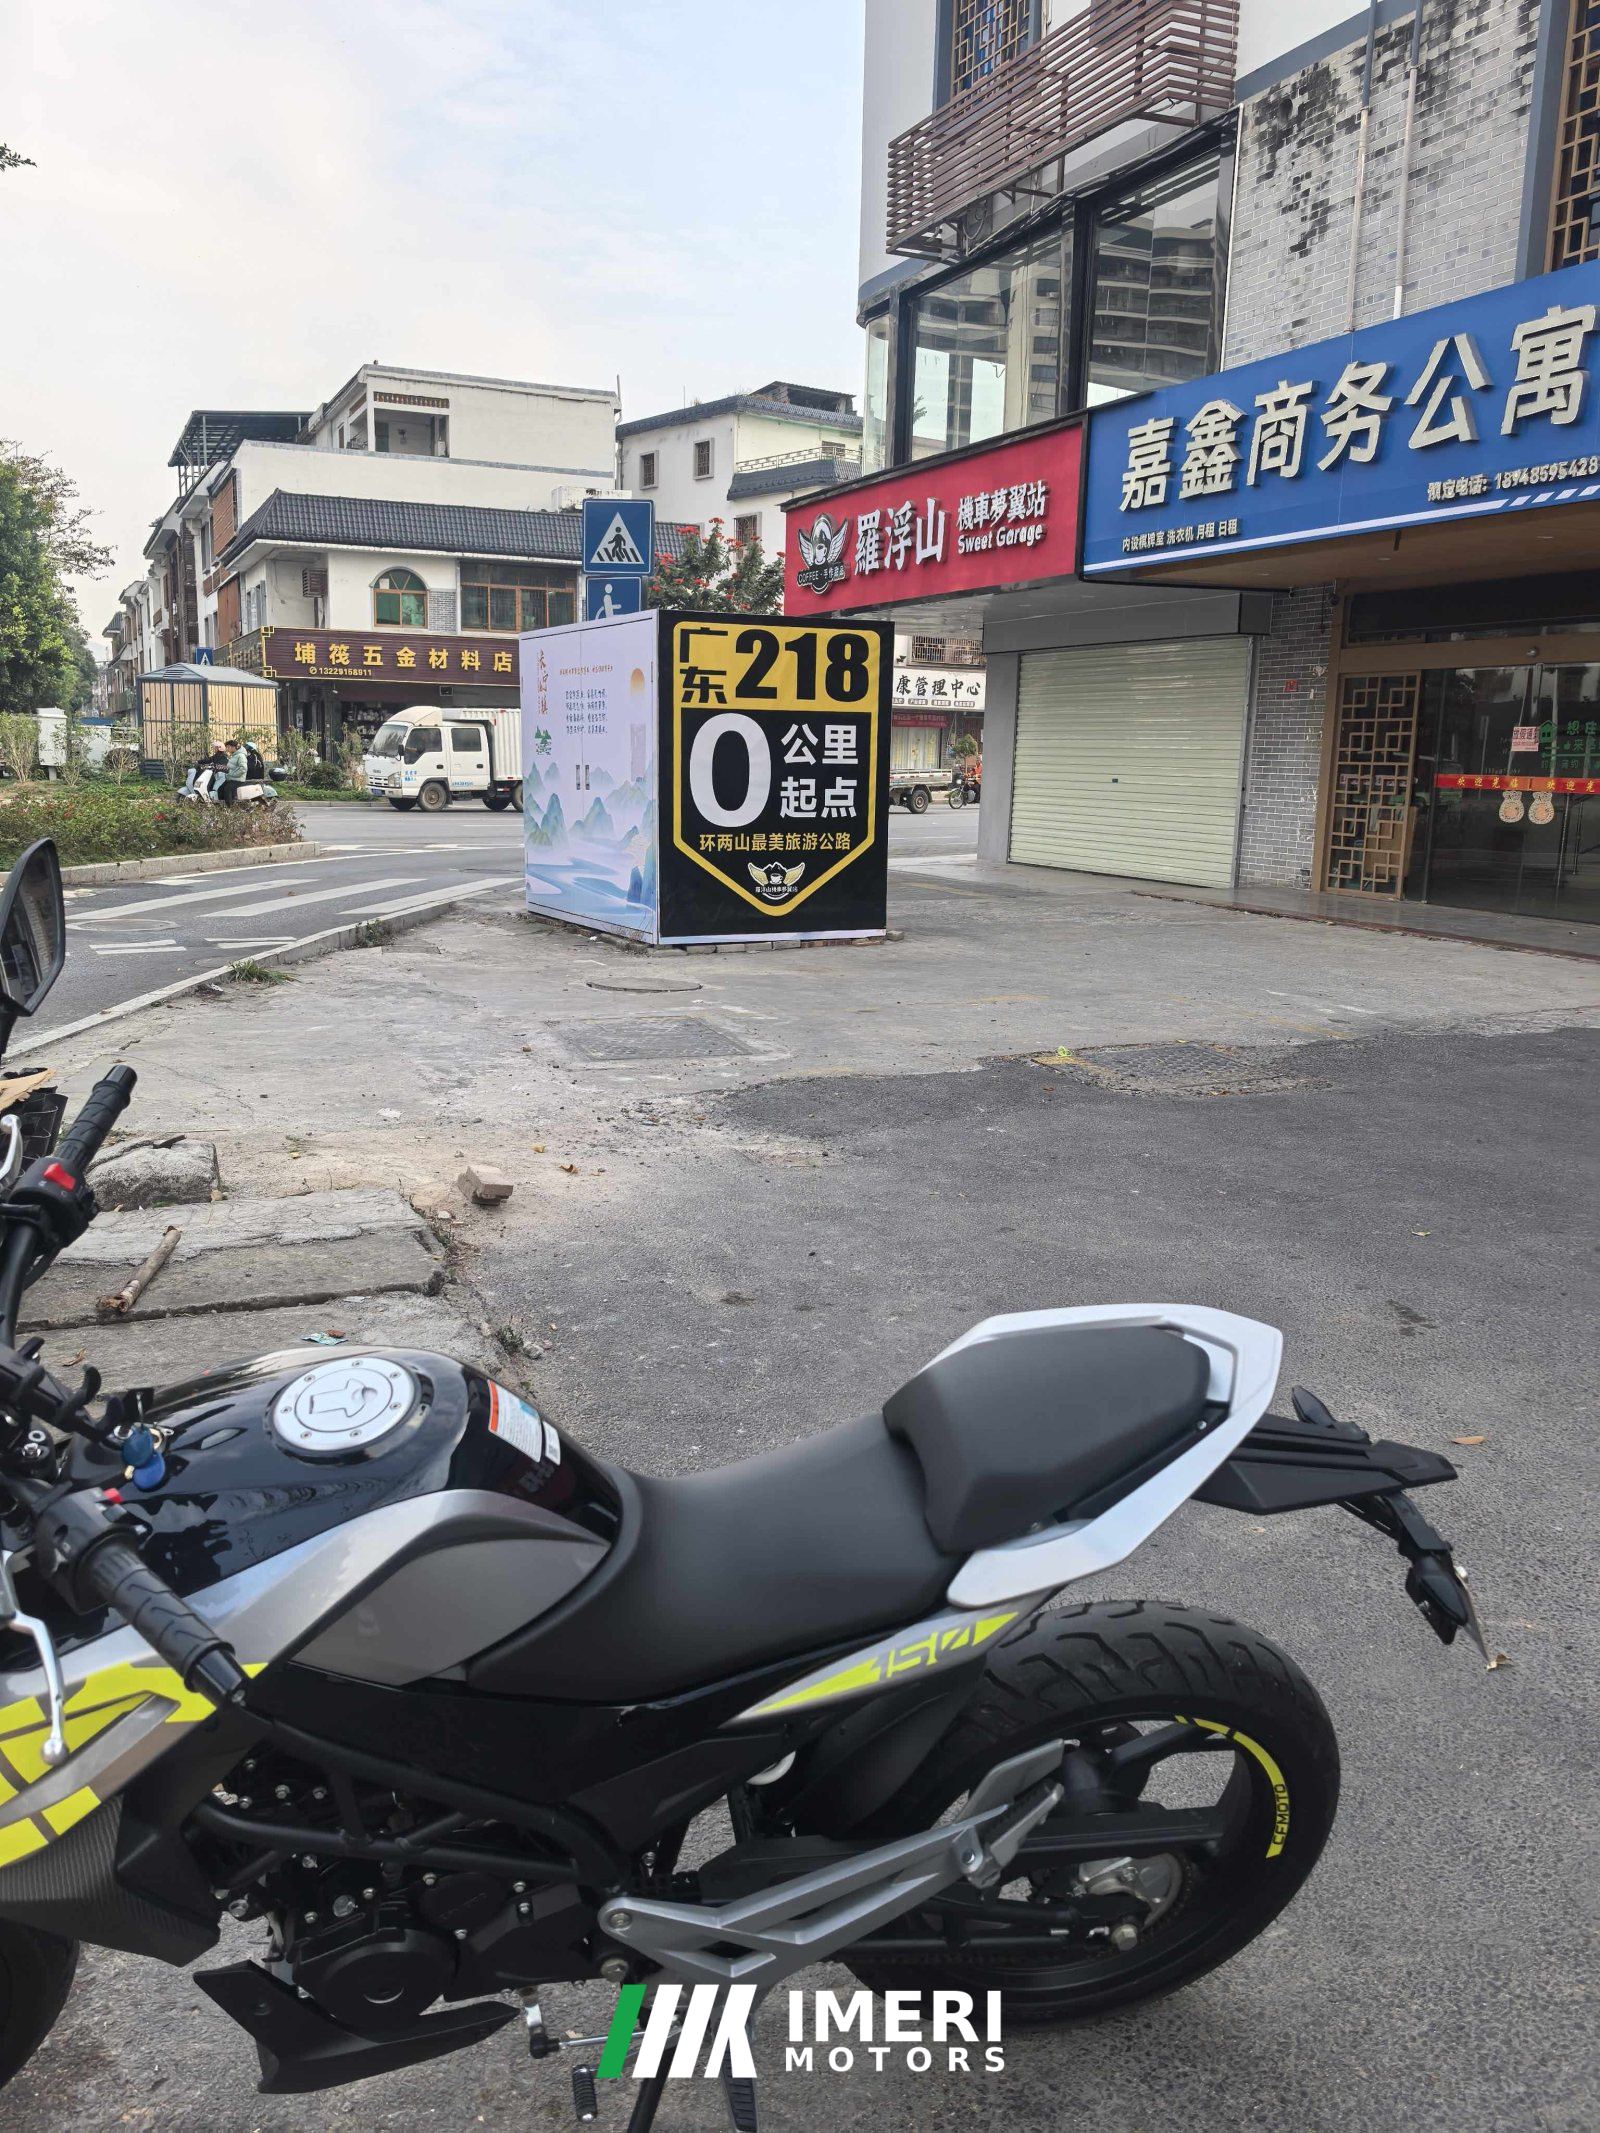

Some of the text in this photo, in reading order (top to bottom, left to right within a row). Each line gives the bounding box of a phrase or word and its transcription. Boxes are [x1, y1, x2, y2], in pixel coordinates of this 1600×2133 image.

[1119, 305, 1599, 512] 嘉鑫商务公寓
[957, 480, 1046, 531] 機車夢翼站
[854, 497, 946, 576] 羅浮山
[957, 524, 1043, 555] Sweet Garage
[1166, 526, 1194, 545] 洗衣机
[1196, 522, 1215, 541] 月租
[1219, 518, 1238, 537] 日租
[295, 642, 513, 672] 埔筏五金材料店
[680, 627, 870, 704] 广东 218
[896, 674, 981, 698] 康管理中心
[781, 723, 859, 765] 公里
[690, 713, 771, 827] 0
[780, 776, 858, 818] 起点
[700, 832, 851, 852] 环两山最美旅游公路
[1273, 1783, 1290, 1845] CFMOTO
